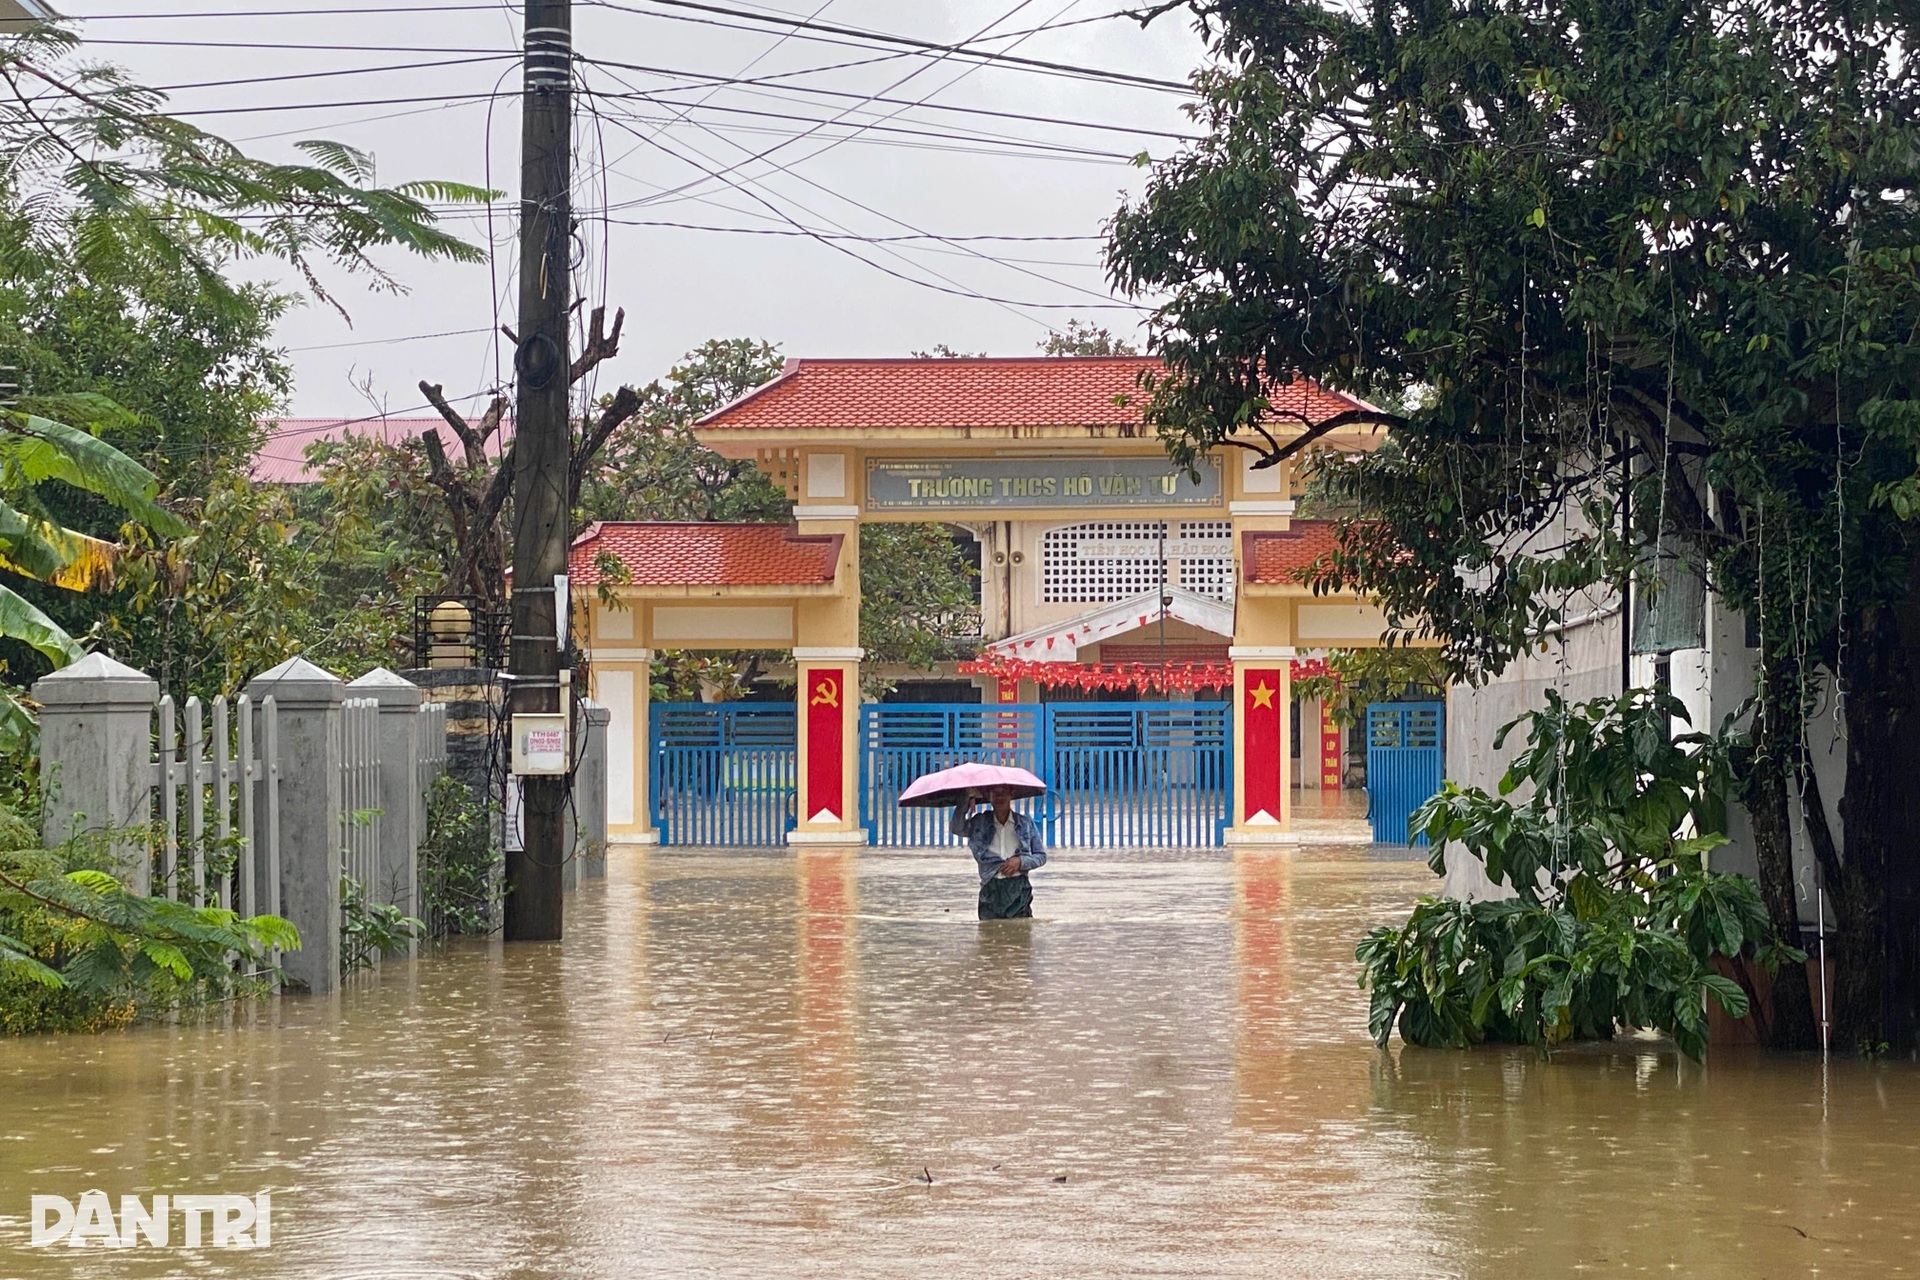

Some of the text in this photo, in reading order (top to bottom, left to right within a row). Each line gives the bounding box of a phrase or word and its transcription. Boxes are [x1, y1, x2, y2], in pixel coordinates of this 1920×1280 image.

[908, 474, 993, 498] TRƯỜNG
[999, 477, 1056, 497] THCS
[1063, 471, 1092, 496] HỒ
[1098, 473, 1141, 496] VĂN
[1119, 545, 1146, 558] HỌC
[1201, 544, 1228, 558] HỌC
